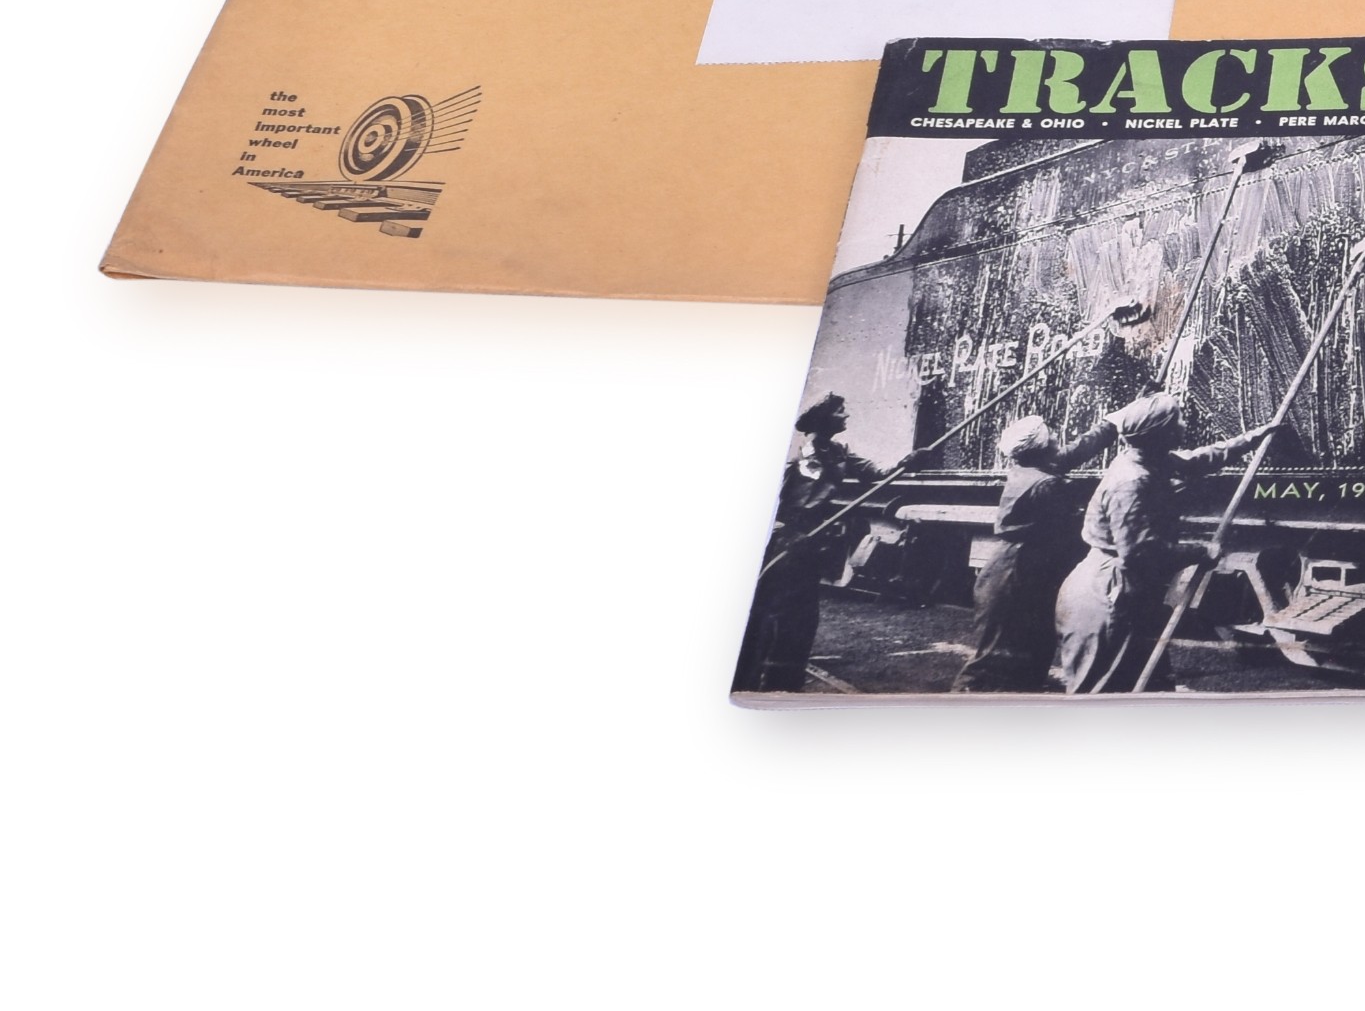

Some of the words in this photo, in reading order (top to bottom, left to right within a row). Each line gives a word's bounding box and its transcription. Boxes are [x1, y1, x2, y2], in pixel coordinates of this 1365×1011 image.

[269, 91, 298, 102] the
[261, 108, 307, 117] most
[910, 118, 1016, 128] CHESAPEAKE
[1021, 119, 1033, 128] &
[1039, 119, 1085, 128] OHIO
[1124, 119, 1183, 128] NICKEL
[1189, 118, 1240, 128] PLATE
[1278, 116, 1318, 126] PERE
[254, 121, 342, 134] important
[248, 138, 299, 149] wheel
[239, 152, 257, 161] in
[231, 166, 305, 178] America
[1254, 482, 1324, 501] MAY,
